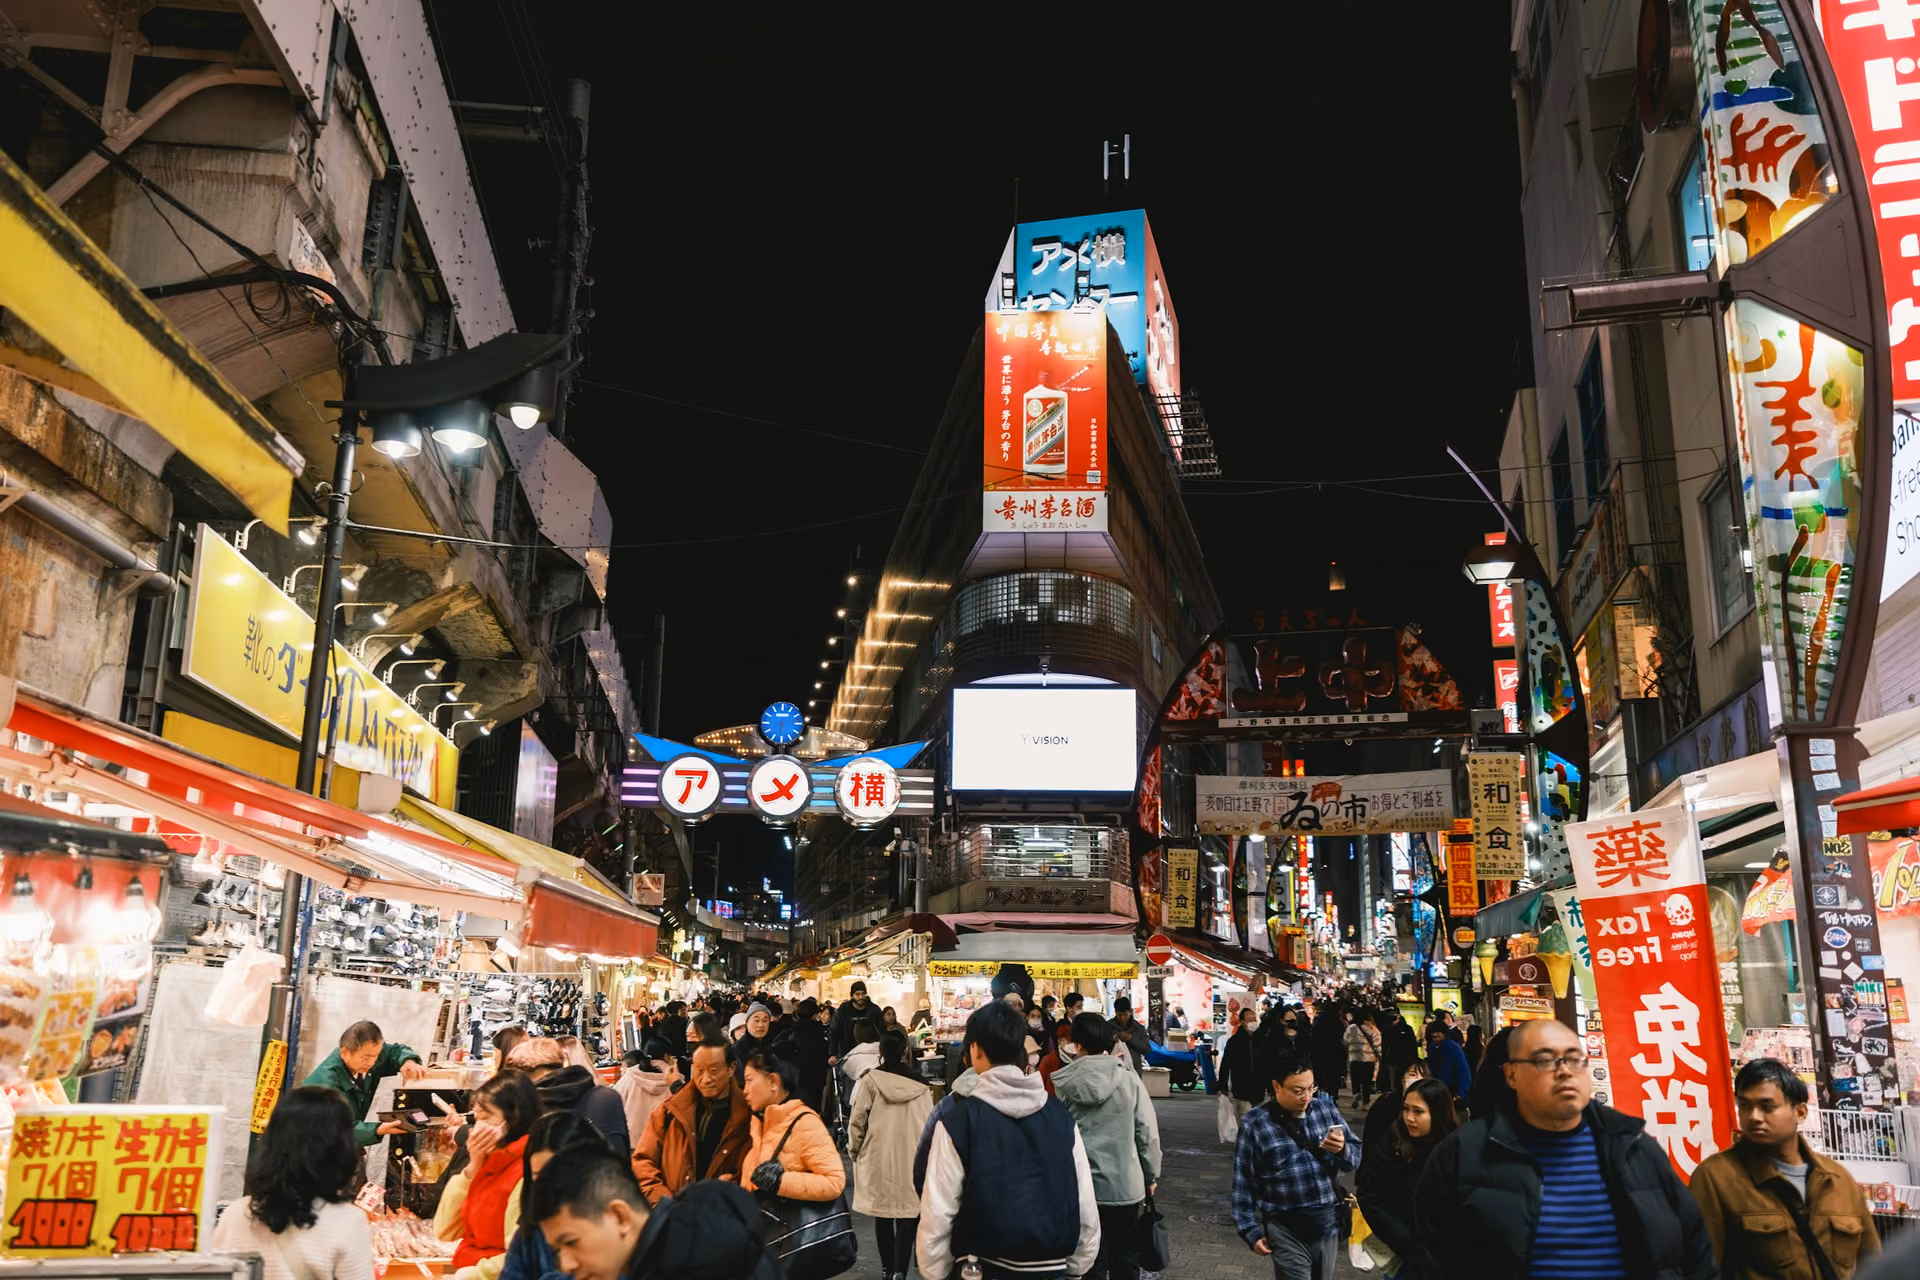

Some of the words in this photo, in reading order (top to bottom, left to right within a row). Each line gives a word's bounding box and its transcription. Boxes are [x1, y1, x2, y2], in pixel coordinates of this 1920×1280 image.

[1032, 233, 1126, 275] アメ横
[1231, 637, 1396, 713] 上中
[1032, 736, 1068, 745] VISION
[674, 769, 887, 808] アメ横
[115, 1117, 208, 1165] 生カキ
[23, 1160, 98, 1199] 7個
[119, 1167, 204, 1212] 7個
